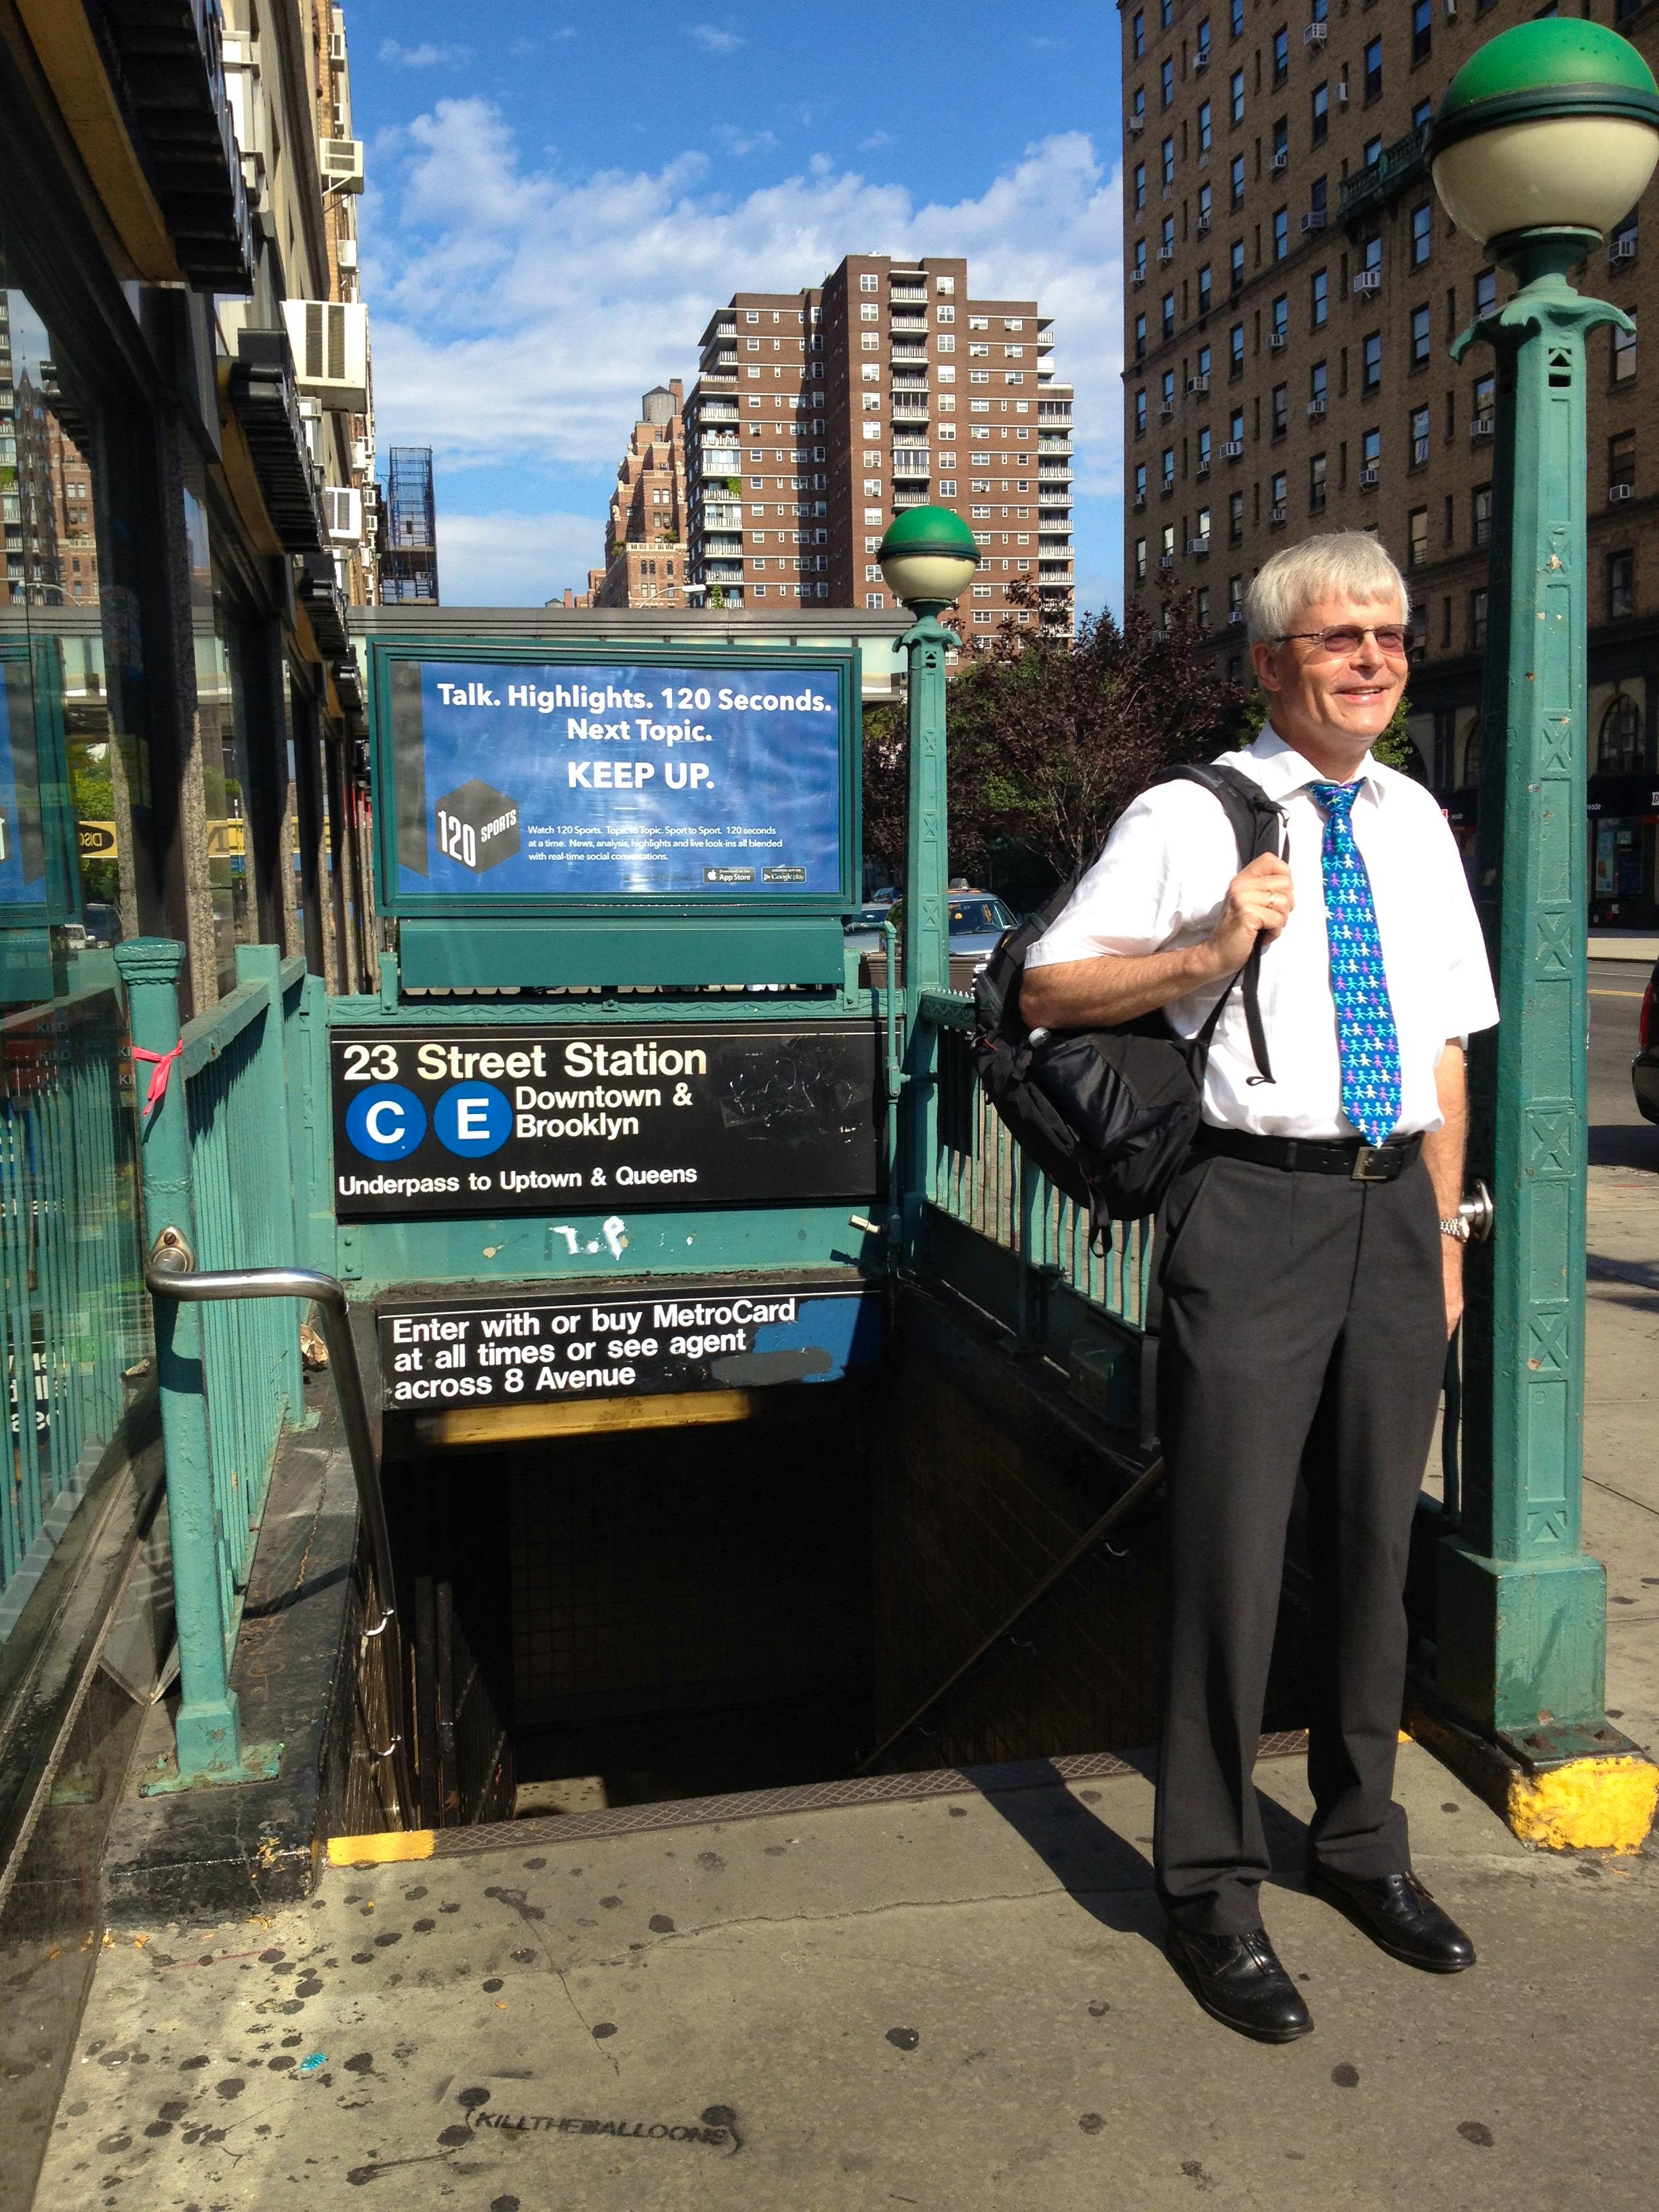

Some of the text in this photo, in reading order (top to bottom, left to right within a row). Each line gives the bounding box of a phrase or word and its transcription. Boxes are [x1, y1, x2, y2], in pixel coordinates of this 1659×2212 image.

[438, 683, 831, 714] Talk. Highlights. 120 Seconds.
[568, 718, 712, 746] Next Topic.
[568, 762, 714, 789] KEEP UP.
[438, 809, 516, 867] 120 SPORTS
[544, 839, 565, 847] time.
[570, 839, 594, 848] News,
[597, 839, 630, 849] analysis,
[632, 839, 671, 849] highlights
[673, 839, 689, 847] and
[691, 839, 703, 847] live
[705, 839, 736, 848] look-ins
[738, 839, 747, 847] all
[749, 839, 782, 848] blended
[574, 826, 602, 836] Sports.
[606, 826, 630, 836] Topic
[640, 826, 663, 836] Topic.
[665, 826, 687, 836] Sport
[688, 826, 697, 834] to
[699, 826, 722, 836] Sport.
[726, 826, 741, 834] 120
[743, 826, 776, 834] seconds
[529, 853, 546, 861] with
[548, 853, 584, 861] real-time
[586, 853, 609, 861] social
[344, 1042, 706, 1080] 23 Street Station
[516, 1082, 693, 1109] Downtown &
[367, 1099, 489, 1143] C E
[516, 1113, 638, 1140] Brooklyn
[340, 1166, 697, 1196] Underpass to Uptown & Queens
[394, 1298, 797, 1343] Enter with or buy MetroCard
[394, 1329, 746, 1372] at all times or see agent
[395, 1367, 636, 1399] across 8 Avenue
